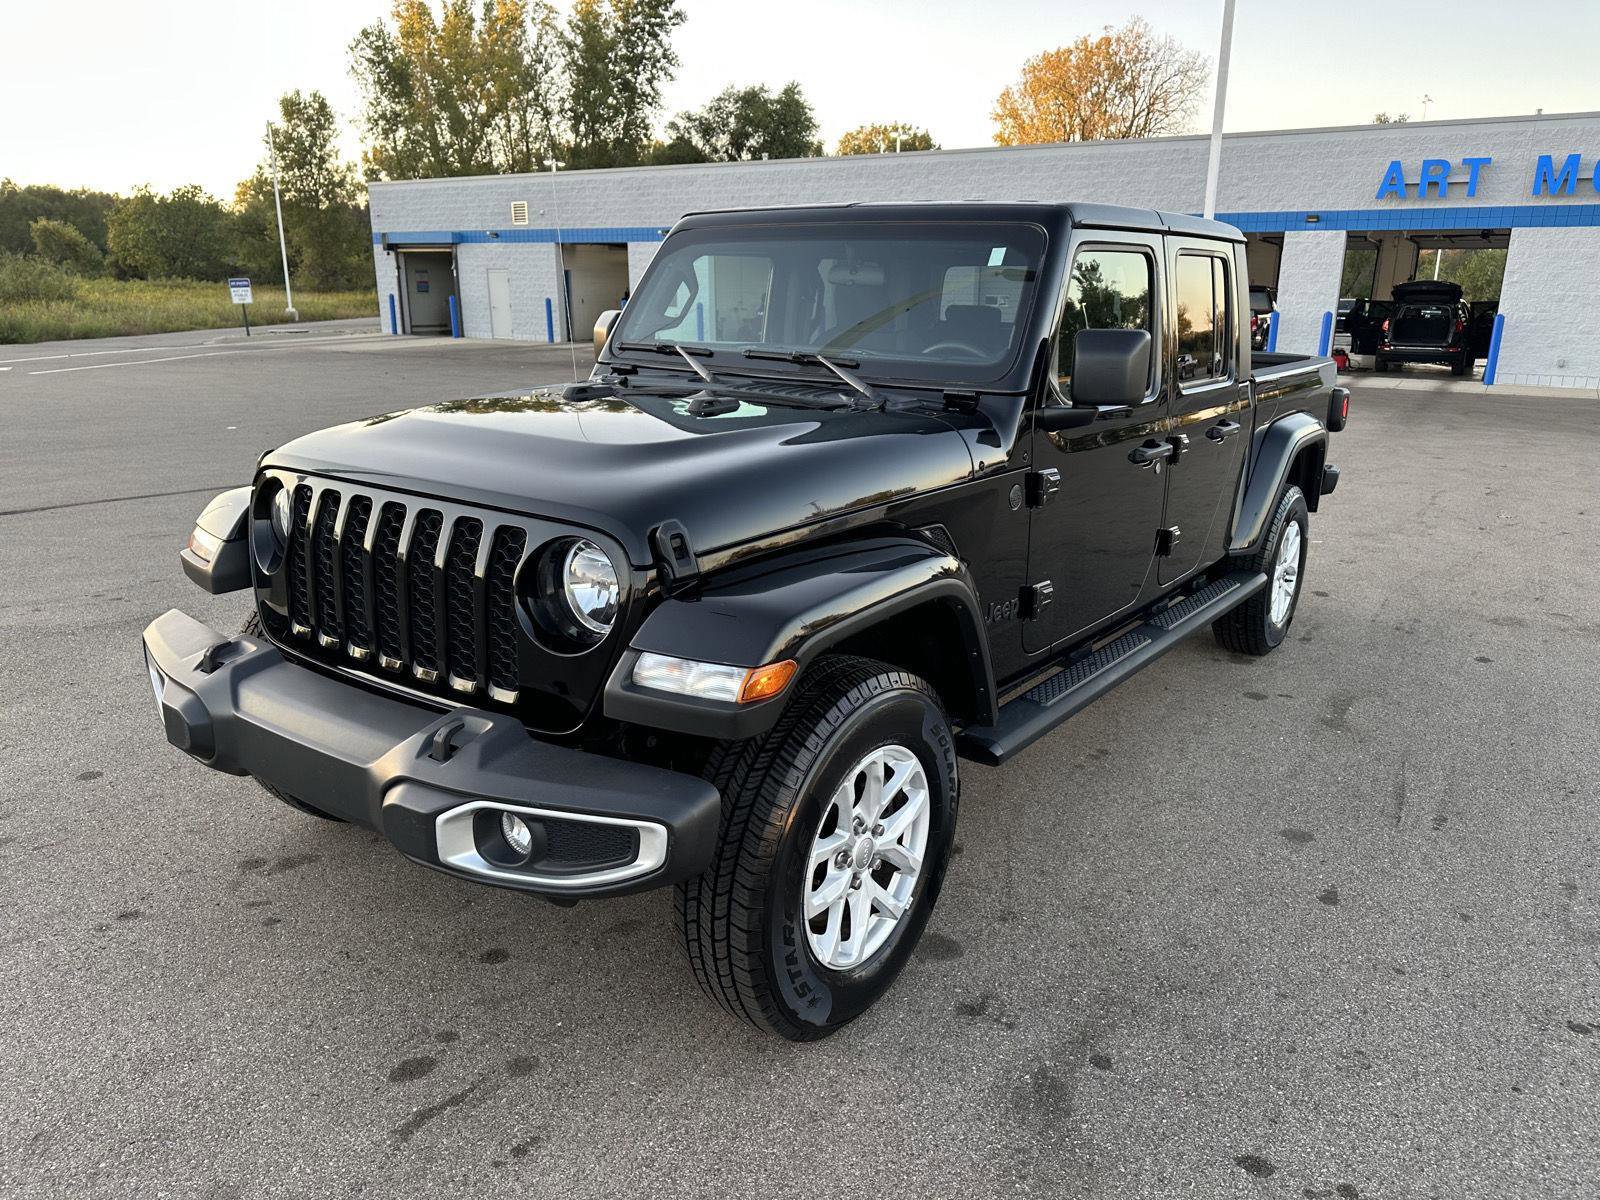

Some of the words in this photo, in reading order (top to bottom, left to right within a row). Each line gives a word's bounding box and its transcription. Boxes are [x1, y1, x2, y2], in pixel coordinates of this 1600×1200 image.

[1375, 157, 1492, 200] ART
[1532, 153, 1600, 196] M
[984, 597, 1019, 622] Jeep
